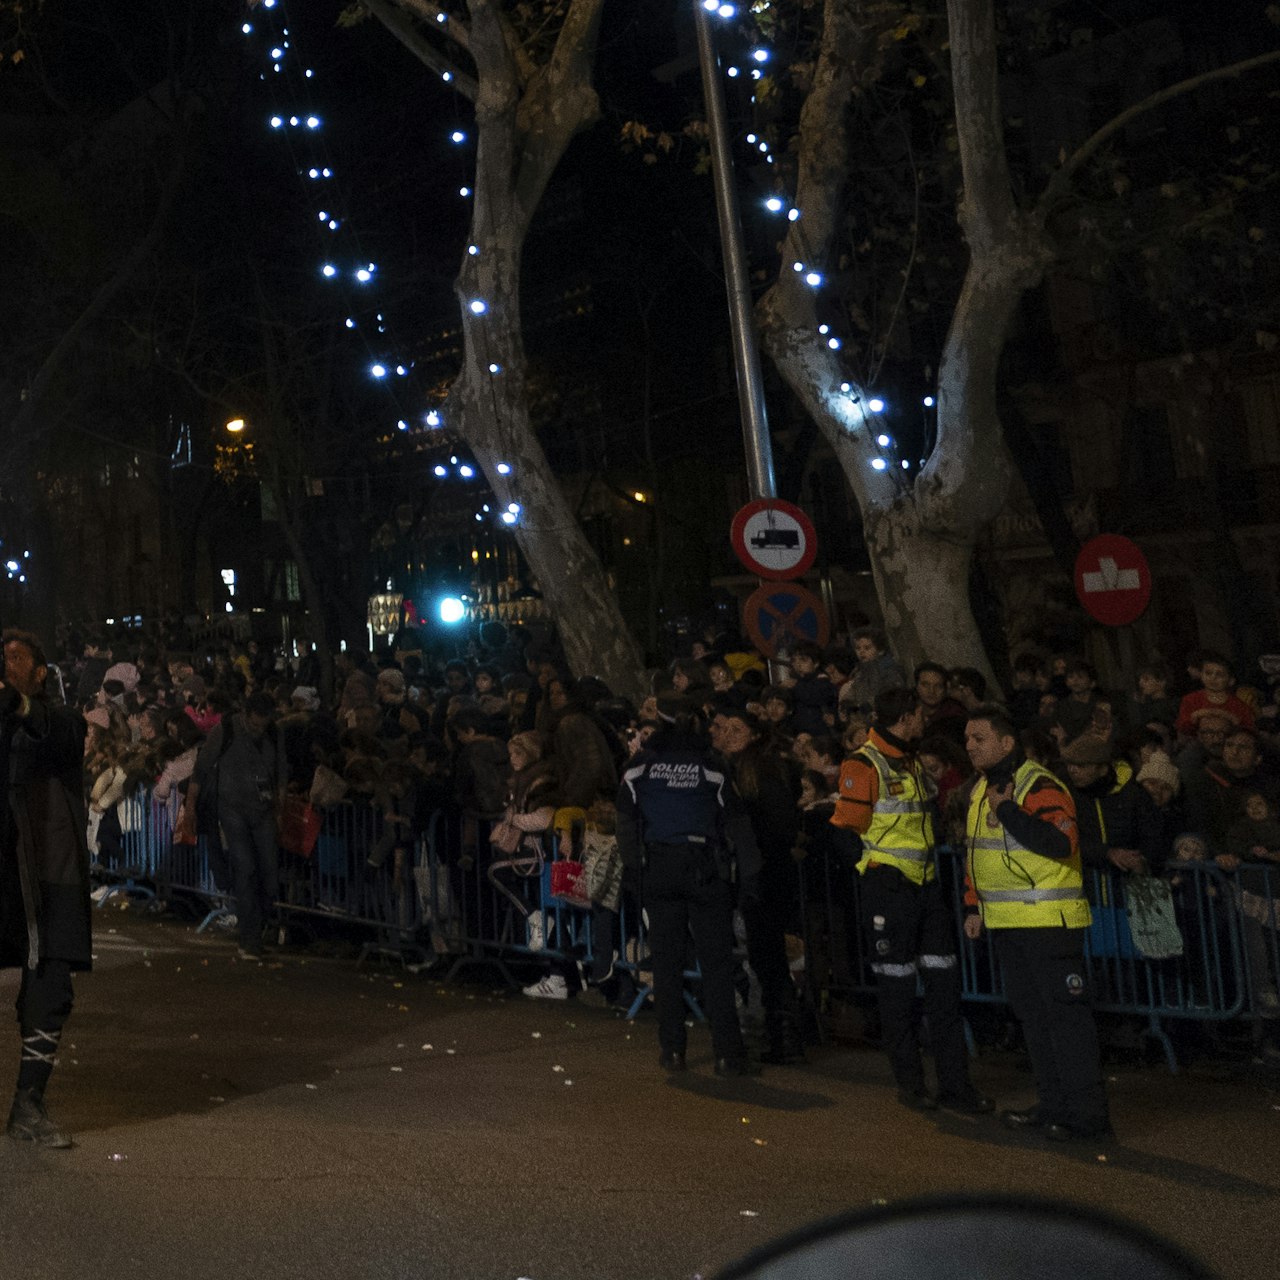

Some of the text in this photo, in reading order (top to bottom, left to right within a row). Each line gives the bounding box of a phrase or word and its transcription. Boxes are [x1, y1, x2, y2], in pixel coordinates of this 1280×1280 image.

[649, 762, 699, 774] POLICÍA
[648, 771, 699, 781] MUNICIPAL
[666, 779, 700, 788] Madrid
